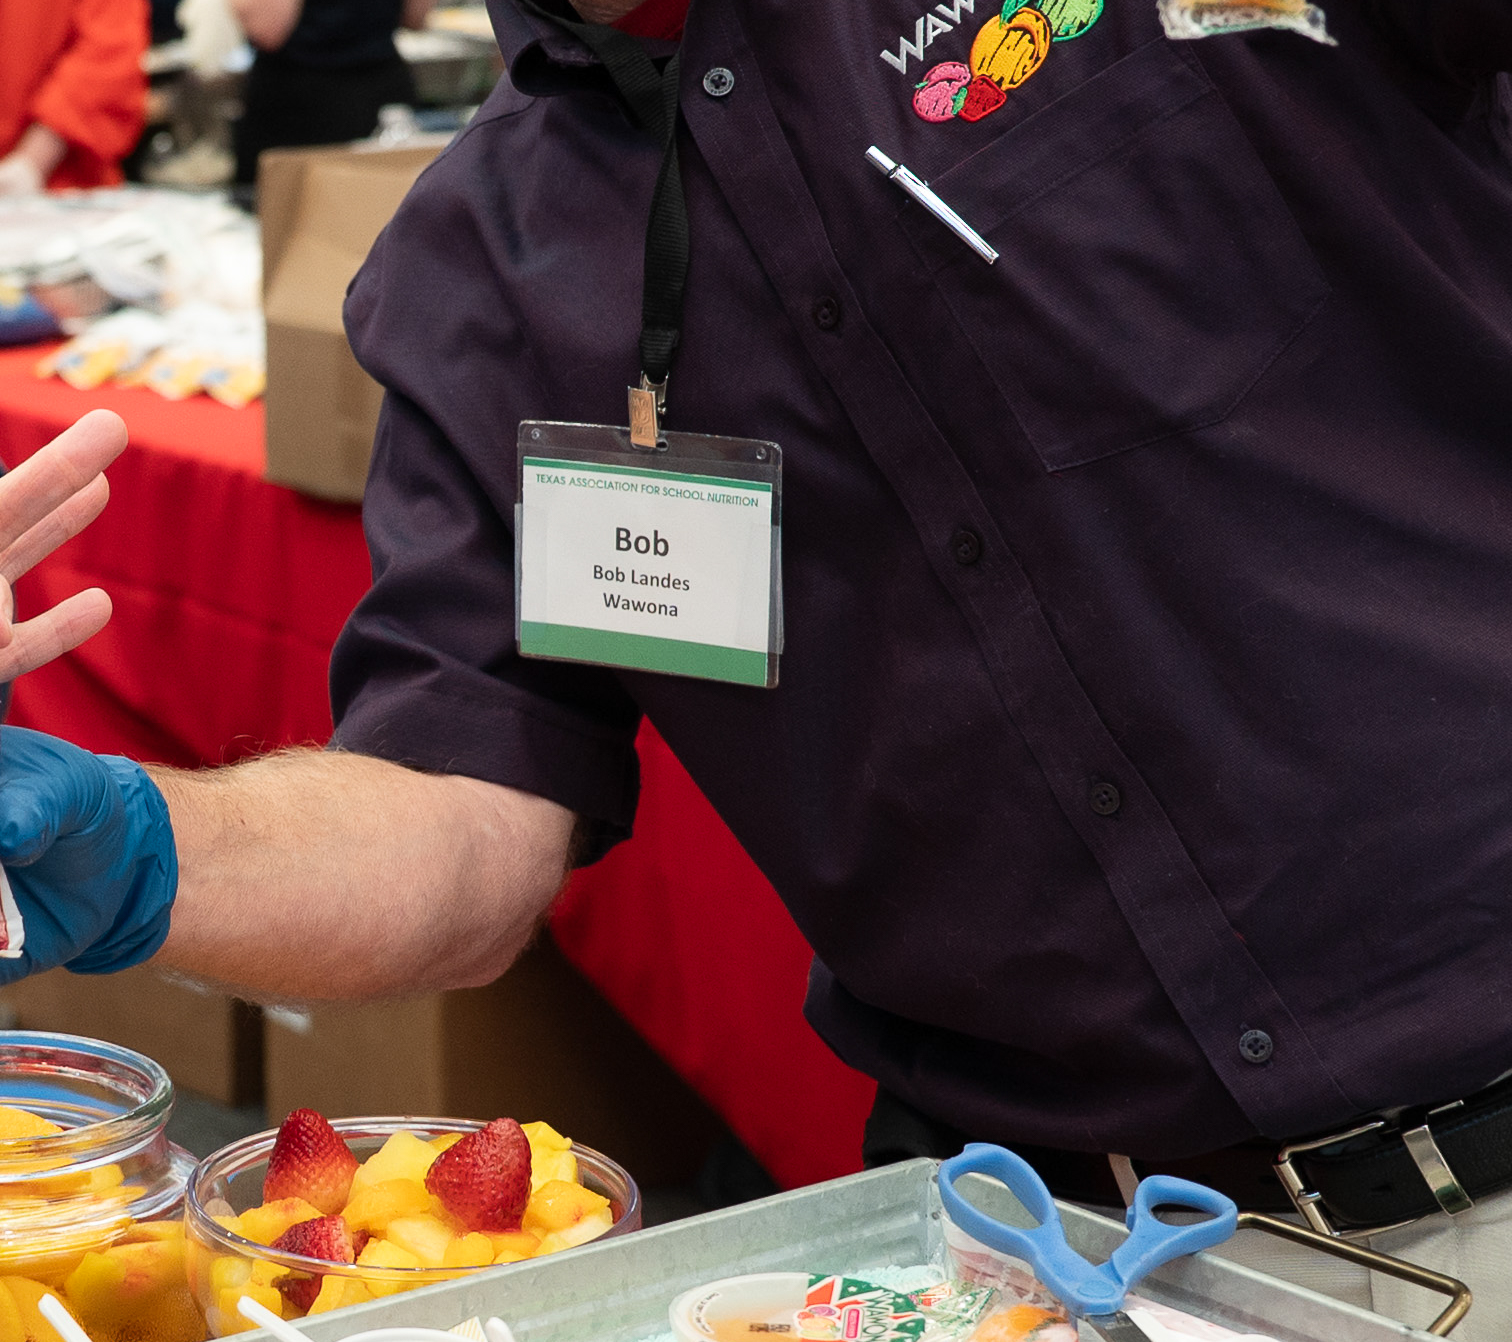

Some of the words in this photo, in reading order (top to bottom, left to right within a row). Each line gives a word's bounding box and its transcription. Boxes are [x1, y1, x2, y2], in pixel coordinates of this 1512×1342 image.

[536, 473, 566, 486] TEXAS
[569, 477, 638, 493] ASSOCIATION
[641, 484, 660, 496] FOR
[663, 486, 705, 501] SCHOOL
[707, 492, 759, 508] NUTRITION
[615, 527, 670, 557] Bob
[593, 565, 626, 583] Bob
[631, 569, 690, 591] Landes
[603, 592, 678, 617] Wawona
